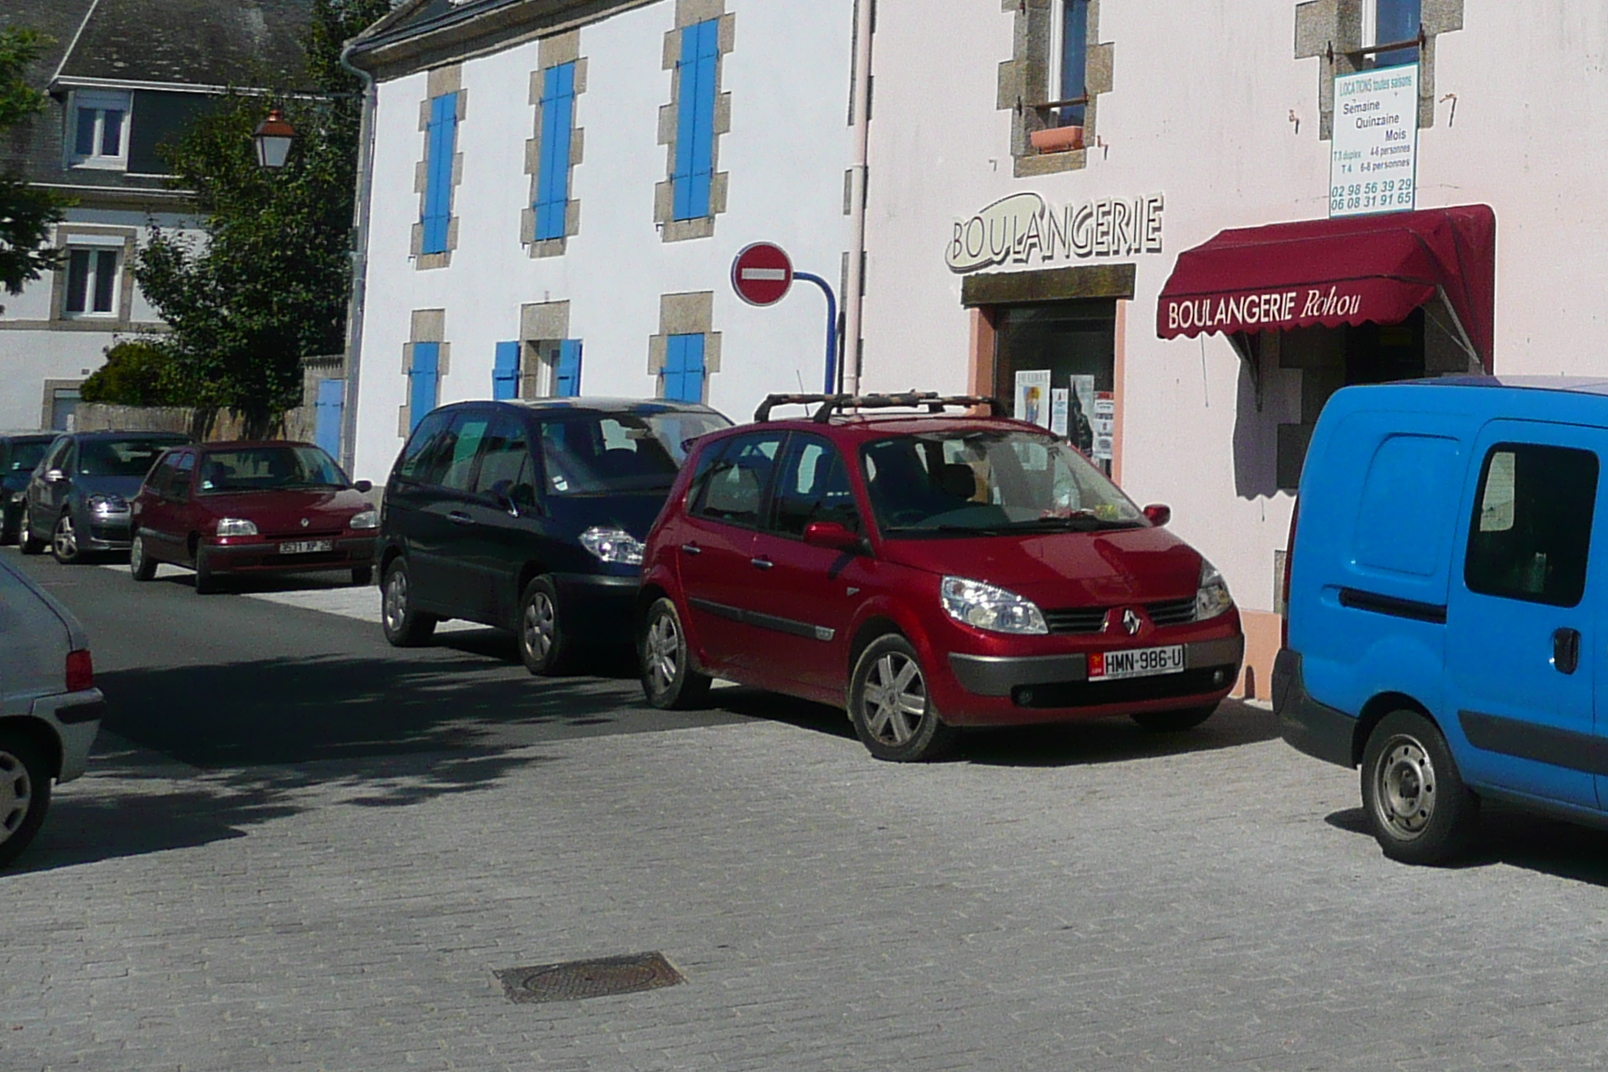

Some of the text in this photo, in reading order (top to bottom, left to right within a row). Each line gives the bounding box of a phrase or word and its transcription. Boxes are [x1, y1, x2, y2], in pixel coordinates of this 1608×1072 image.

[1343, 100, 1380, 115] Semaine
[1355, 113, 1400, 129] Quinzaine
[1385, 128, 1407, 141] Mois
[1380, 144, 1410, 157] personnes
[1372, 159, 1410, 173] personnes
[1331, 178, 1411, 198] 02 98 56 39 29
[1331, 191, 1411, 210] 06 08 31 91 65
[950, 193, 1163, 264] BOULANGERIE
[1168, 285, 1361, 329] BOULANGERIE Rohou
